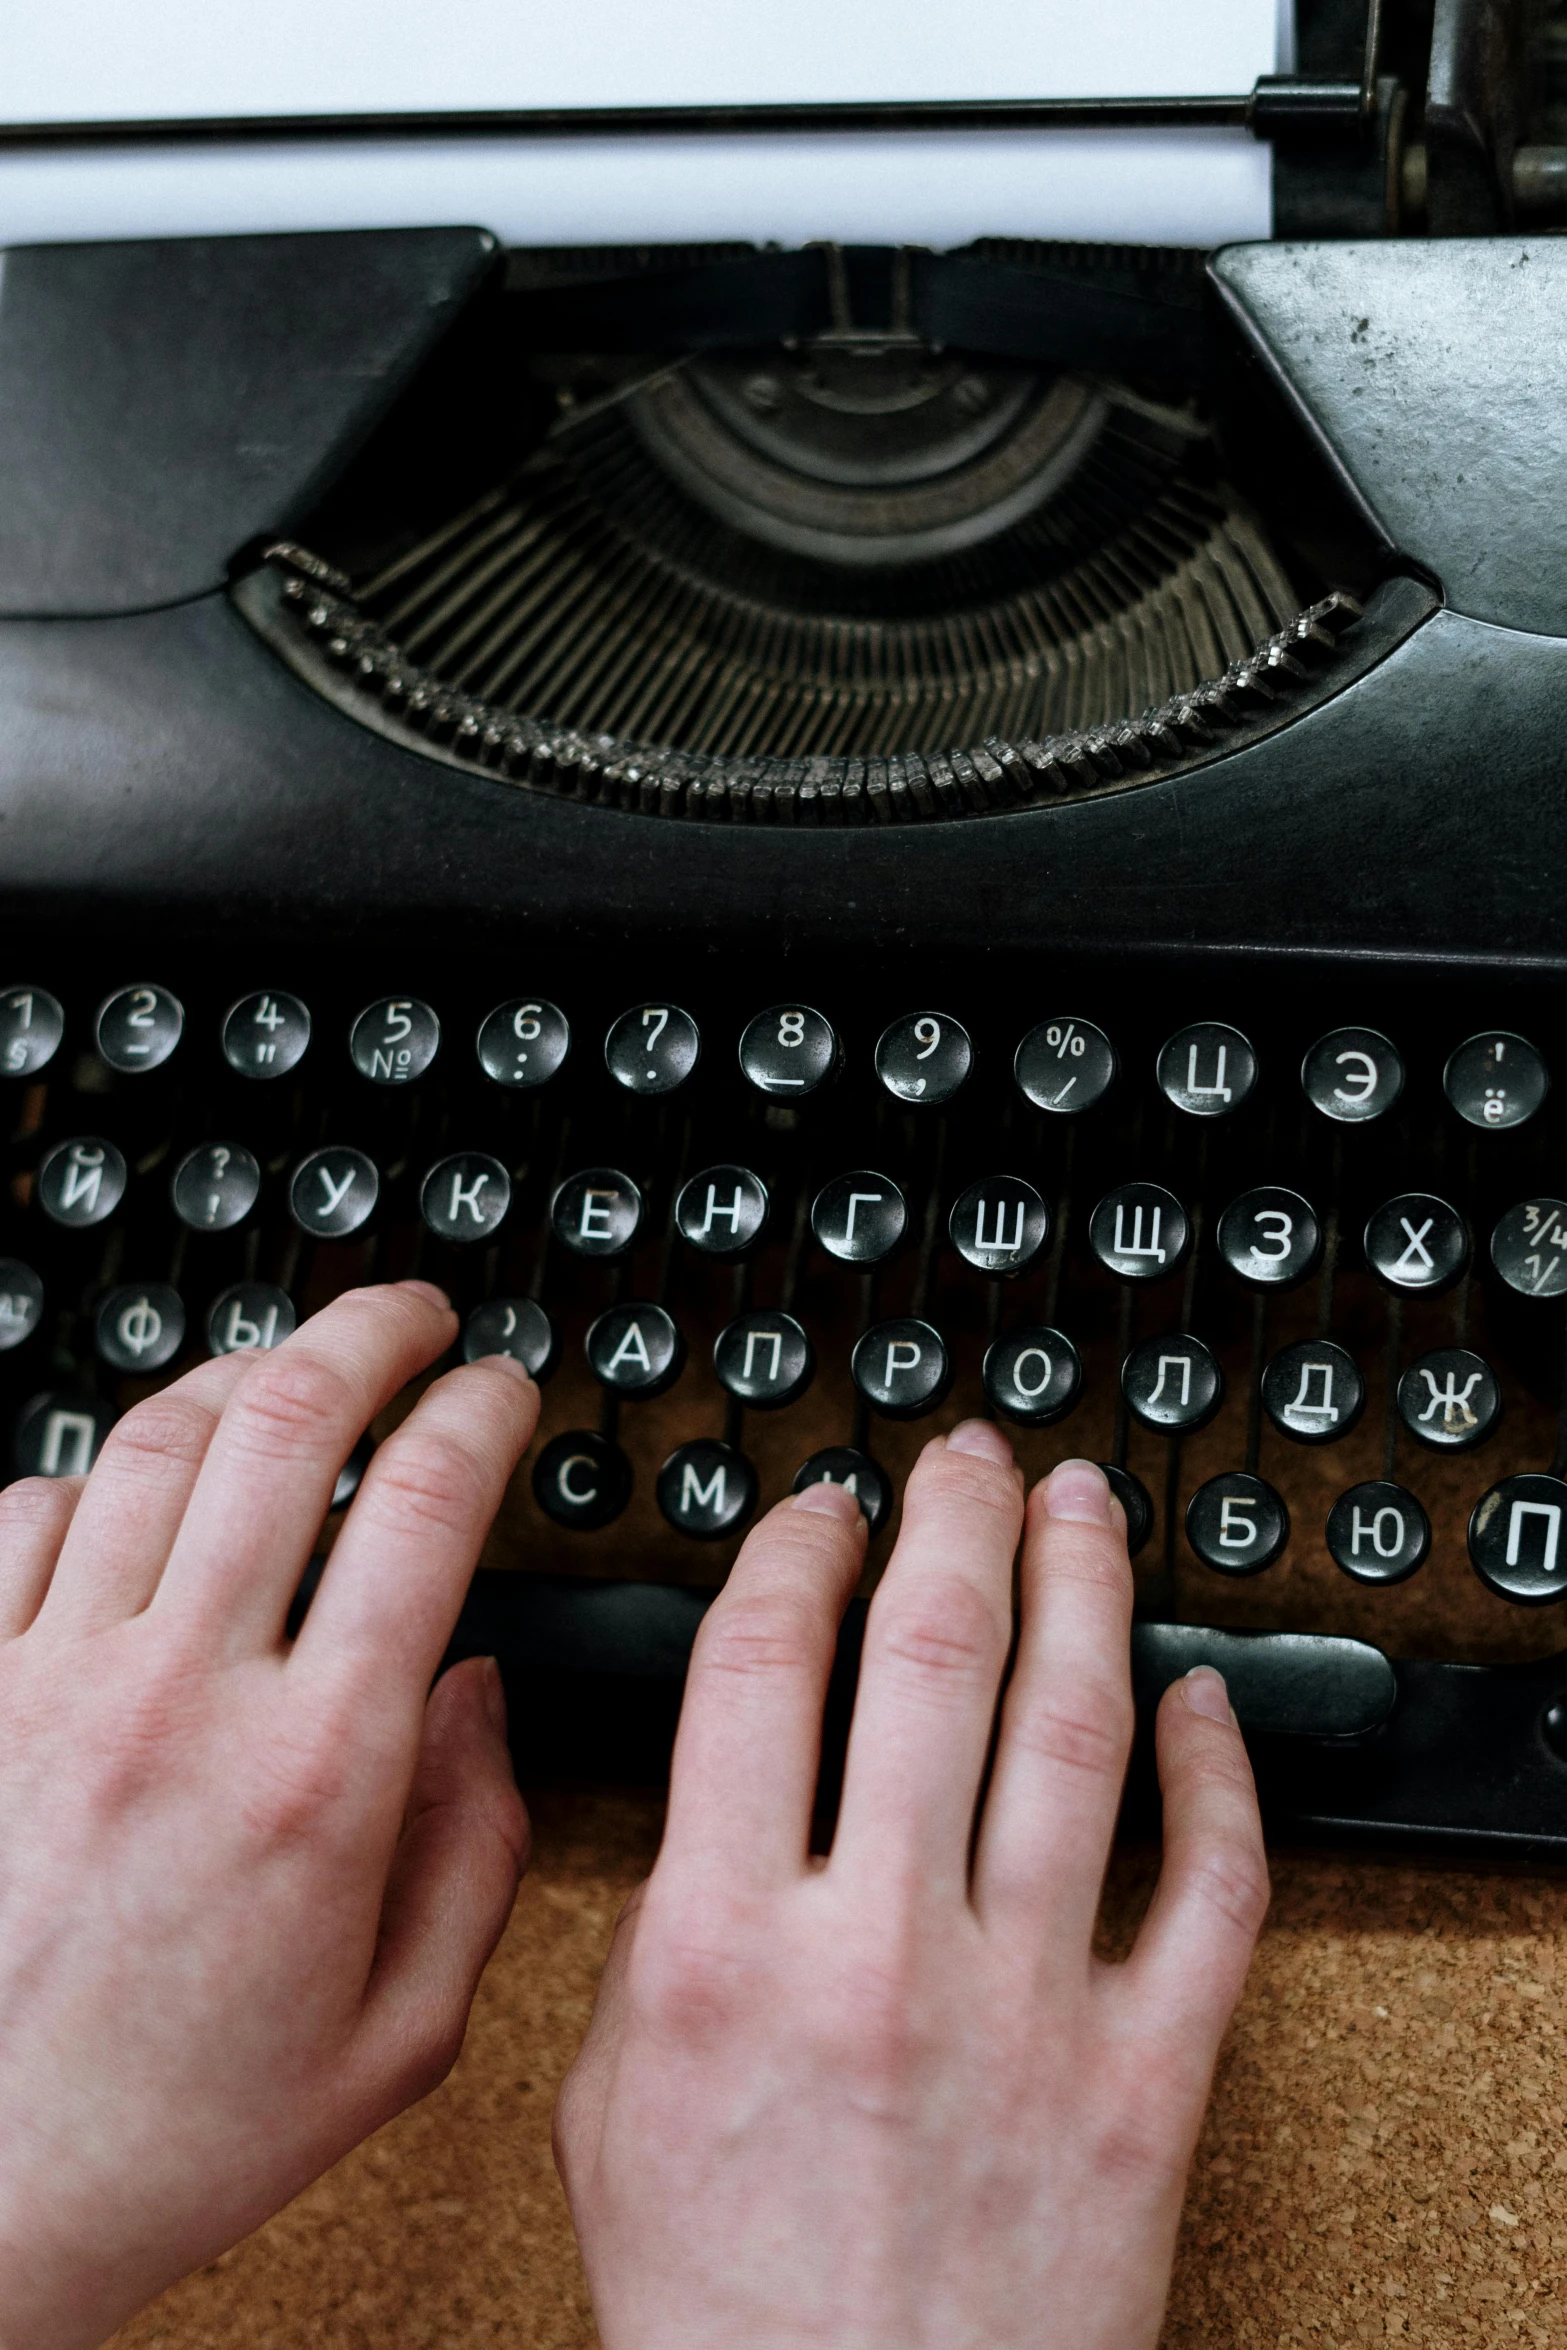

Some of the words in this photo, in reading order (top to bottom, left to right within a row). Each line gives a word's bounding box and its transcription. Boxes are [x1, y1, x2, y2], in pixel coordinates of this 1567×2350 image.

[12, 993, 33, 1030] 1
[129, 990, 157, 1027] 2
[255, 996, 286, 1031] 4
[384, 1003, 412, 1043] 5
[514, 1004, 543, 1040] 6
[642, 1008, 669, 1051] 7
[777, 1011, 804, 1048] 8
[914, 1017, 941, 1060] 9
[1046, 1024, 1085, 1058] %
[1187, 1044, 1232, 1103] Ц
[1334, 1051, 1377, 1101] Э
[62, 1145, 105, 1213] Й
[213, 1147, 231, 1179] ?
[206, 1194, 221, 1223] !
[318, 1166, 356, 1216] У
[448, 1173, 489, 1223] К
[580, 1188, 620, 1240] Е
[704, 1184, 742, 1234] Н
[846, 1193, 882, 1240] Г
[974, 1200, 1025, 1250] Ш
[1114, 1204, 1166, 1263] Щ
[1398, 1216, 1434, 1268] Х
[117, 1297, 163, 1356] Ф
[224, 1301, 279, 1350] Ы
[609, 1321, 651, 1372] А
[742, 1331, 783, 1381] П
[884, 1341, 921, 1388] Р
[1013, 1347, 1052, 1397] О
[1147, 1355, 1191, 1407] Л
[1283, 1362, 1339, 1423] Д
[1417, 1368, 1483, 1426] Ж
[557, 1454, 599, 1505] С
[681, 1462, 727, 1516] М
[1218, 1496, 1258, 1548] Б
[1351, 1505, 1405, 1558] Ю
[1505, 1500, 1561, 1571] П
